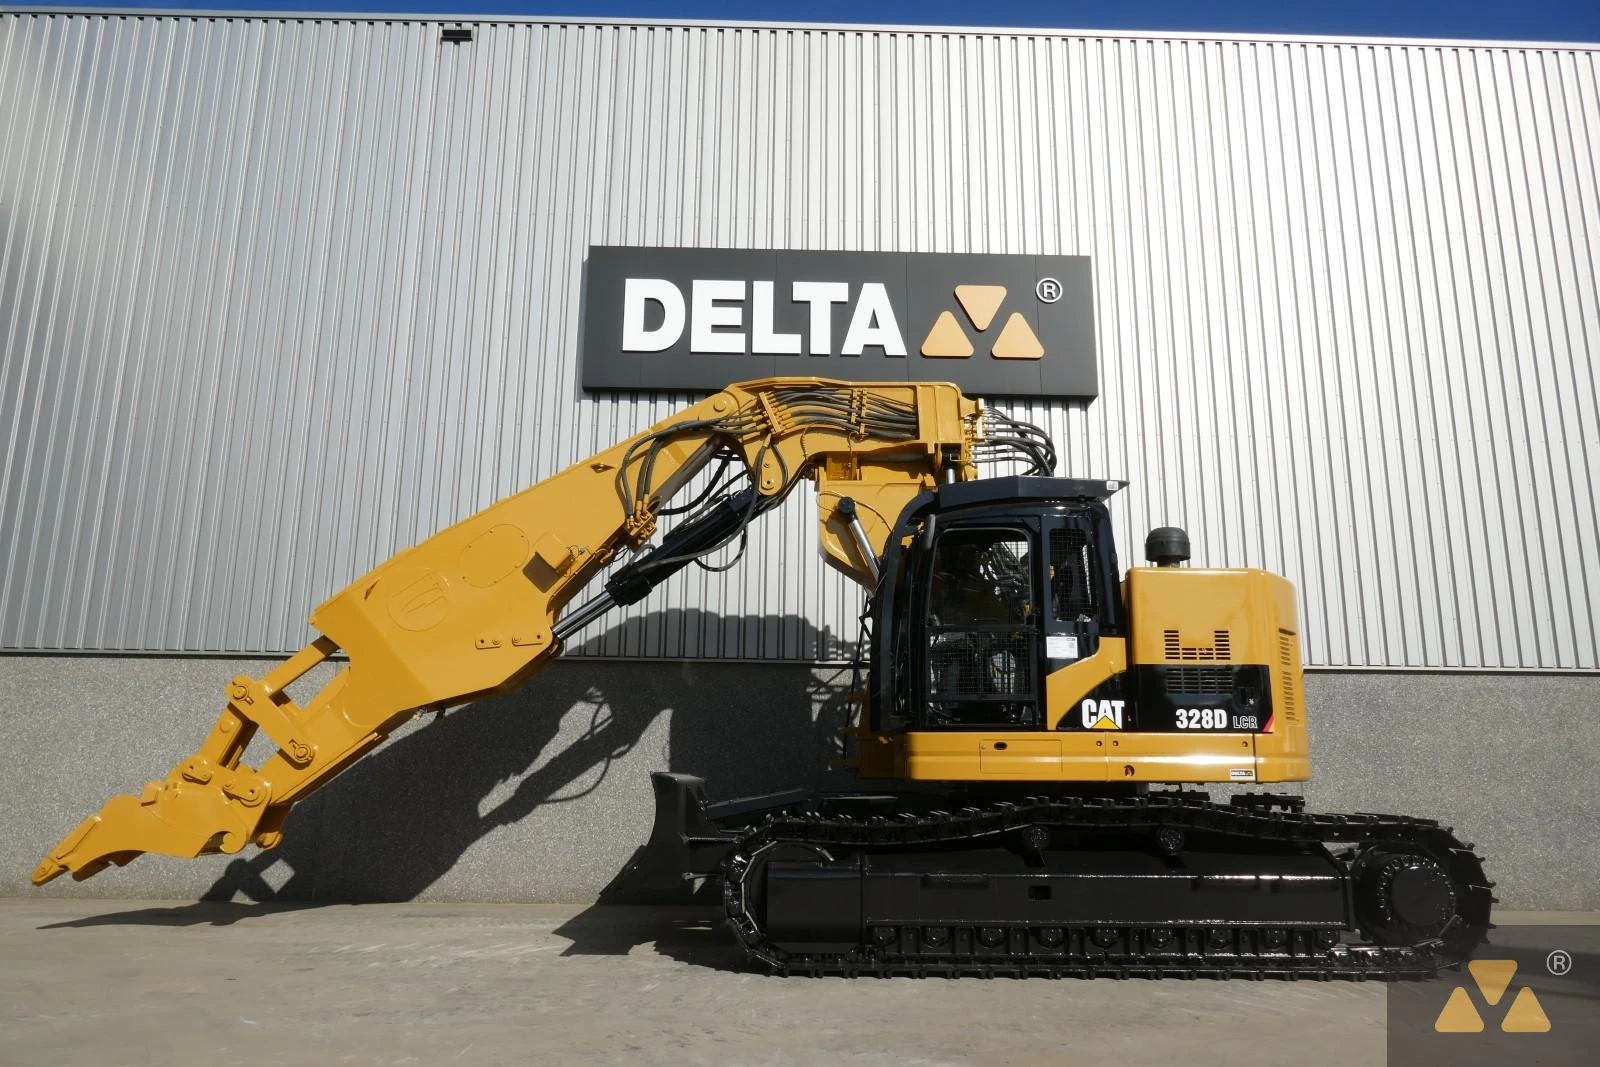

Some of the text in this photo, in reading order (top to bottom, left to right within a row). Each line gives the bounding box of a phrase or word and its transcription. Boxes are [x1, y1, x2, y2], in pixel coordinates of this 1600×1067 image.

[622, 278, 908, 356] DELTA
[1081, 698, 1125, 729] CAT
[1175, 708, 1258, 729] 328D LCR
